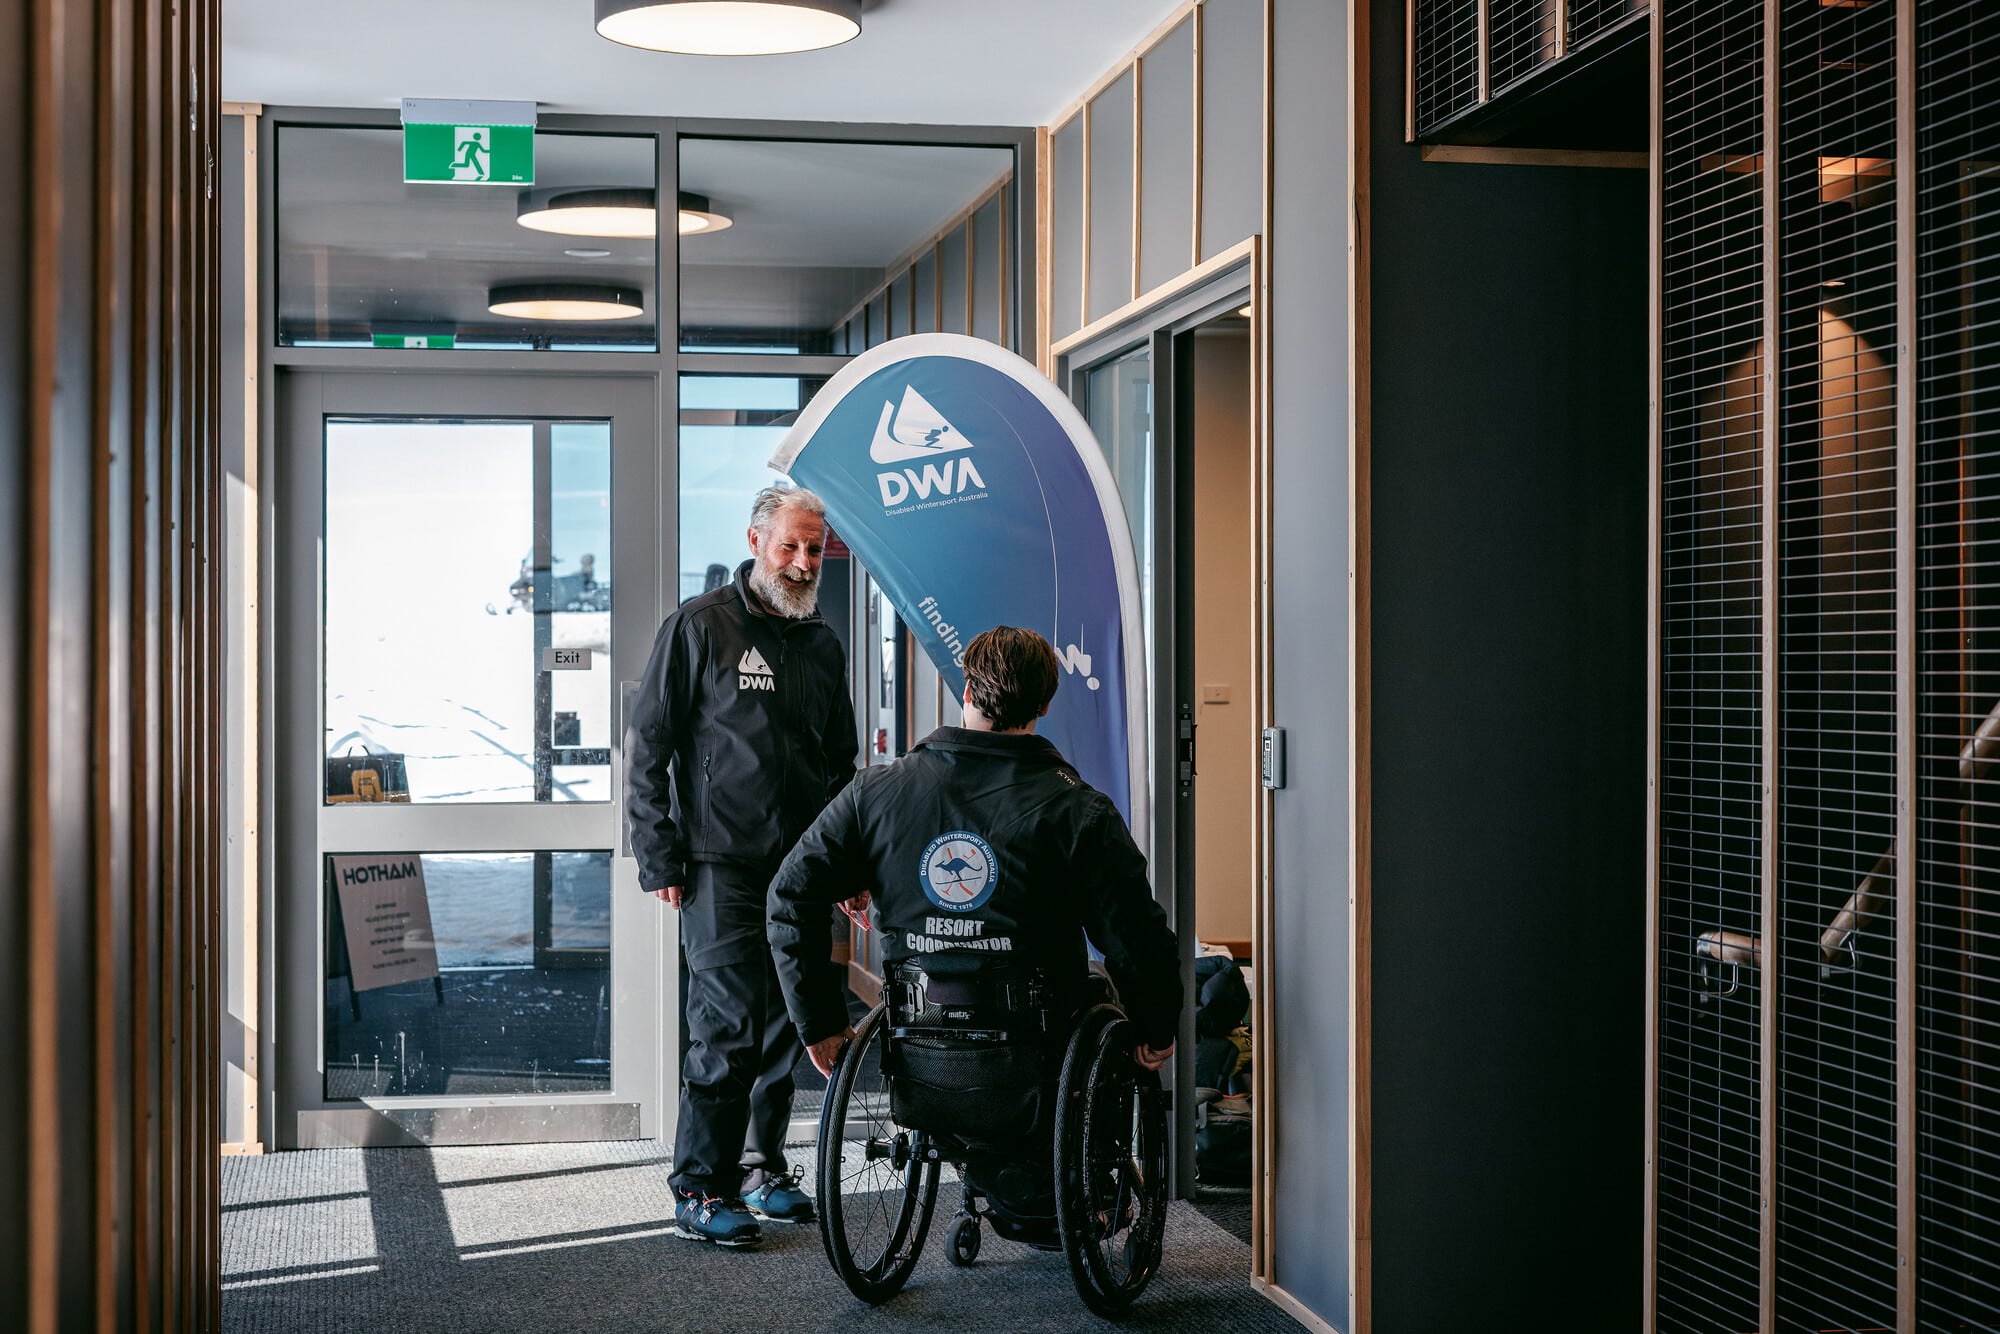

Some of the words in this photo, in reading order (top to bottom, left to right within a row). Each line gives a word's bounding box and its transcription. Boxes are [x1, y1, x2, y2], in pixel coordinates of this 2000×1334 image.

[877, 457, 986, 507] DWA
[885, 505, 915, 517] Disabled
[915, 497, 957, 510] Wintersport
[958, 492, 988, 503] Australia
[918, 596, 965, 668] finding
[555, 651, 580, 664] Exit
[739, 675, 776, 692] DWA
[920, 843, 937, 876] DISABLED
[935, 833, 983, 846] WINTERSPORT
[981, 845, 996, 882] AUSTRALIA
[342, 861, 417, 886] HOTHAM
[938, 900, 957, 910] SINCE
[925, 916, 985, 937] RESORT
